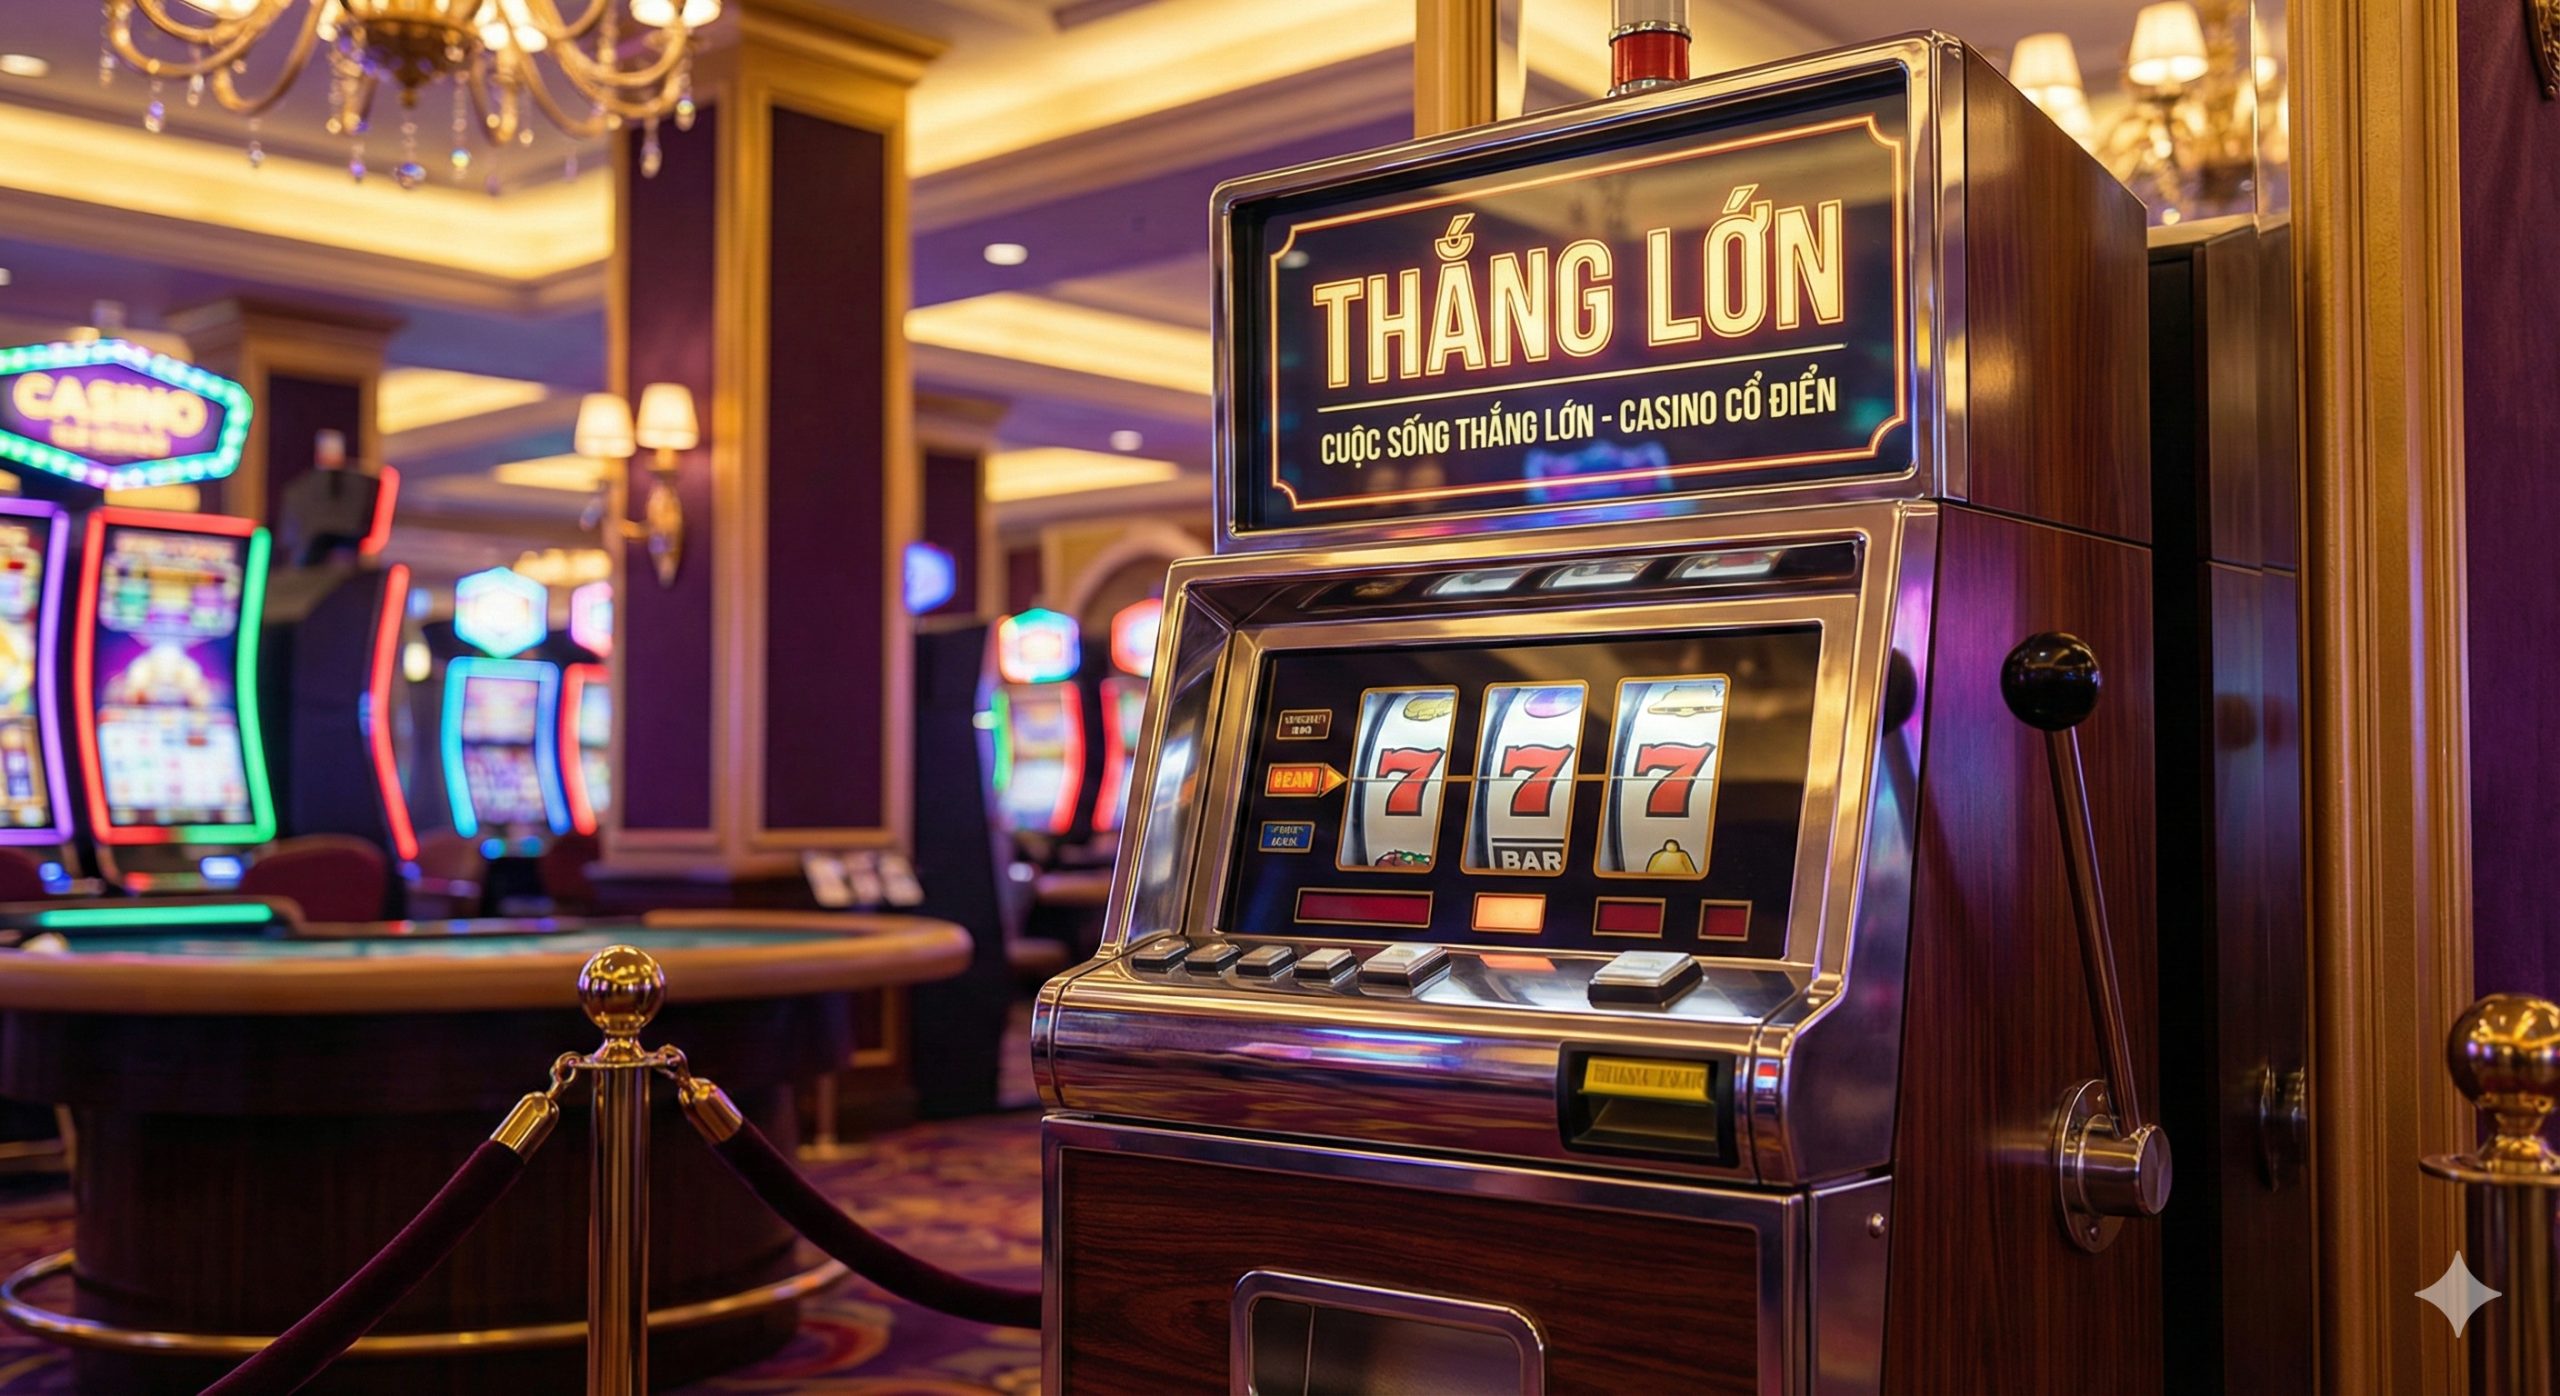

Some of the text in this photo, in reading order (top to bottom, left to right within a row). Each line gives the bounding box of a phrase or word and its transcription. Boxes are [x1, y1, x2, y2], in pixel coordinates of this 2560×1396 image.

[1313, 183, 1845, 389] THẮNG LỚN
[1321, 363, 1837, 468] CUỘC SỐNG THẮNG LỚN - CASINO CỔ ĐIỂN
[1375, 742, 1716, 818] 7 7 7
[1501, 850, 1562, 872] BAR
